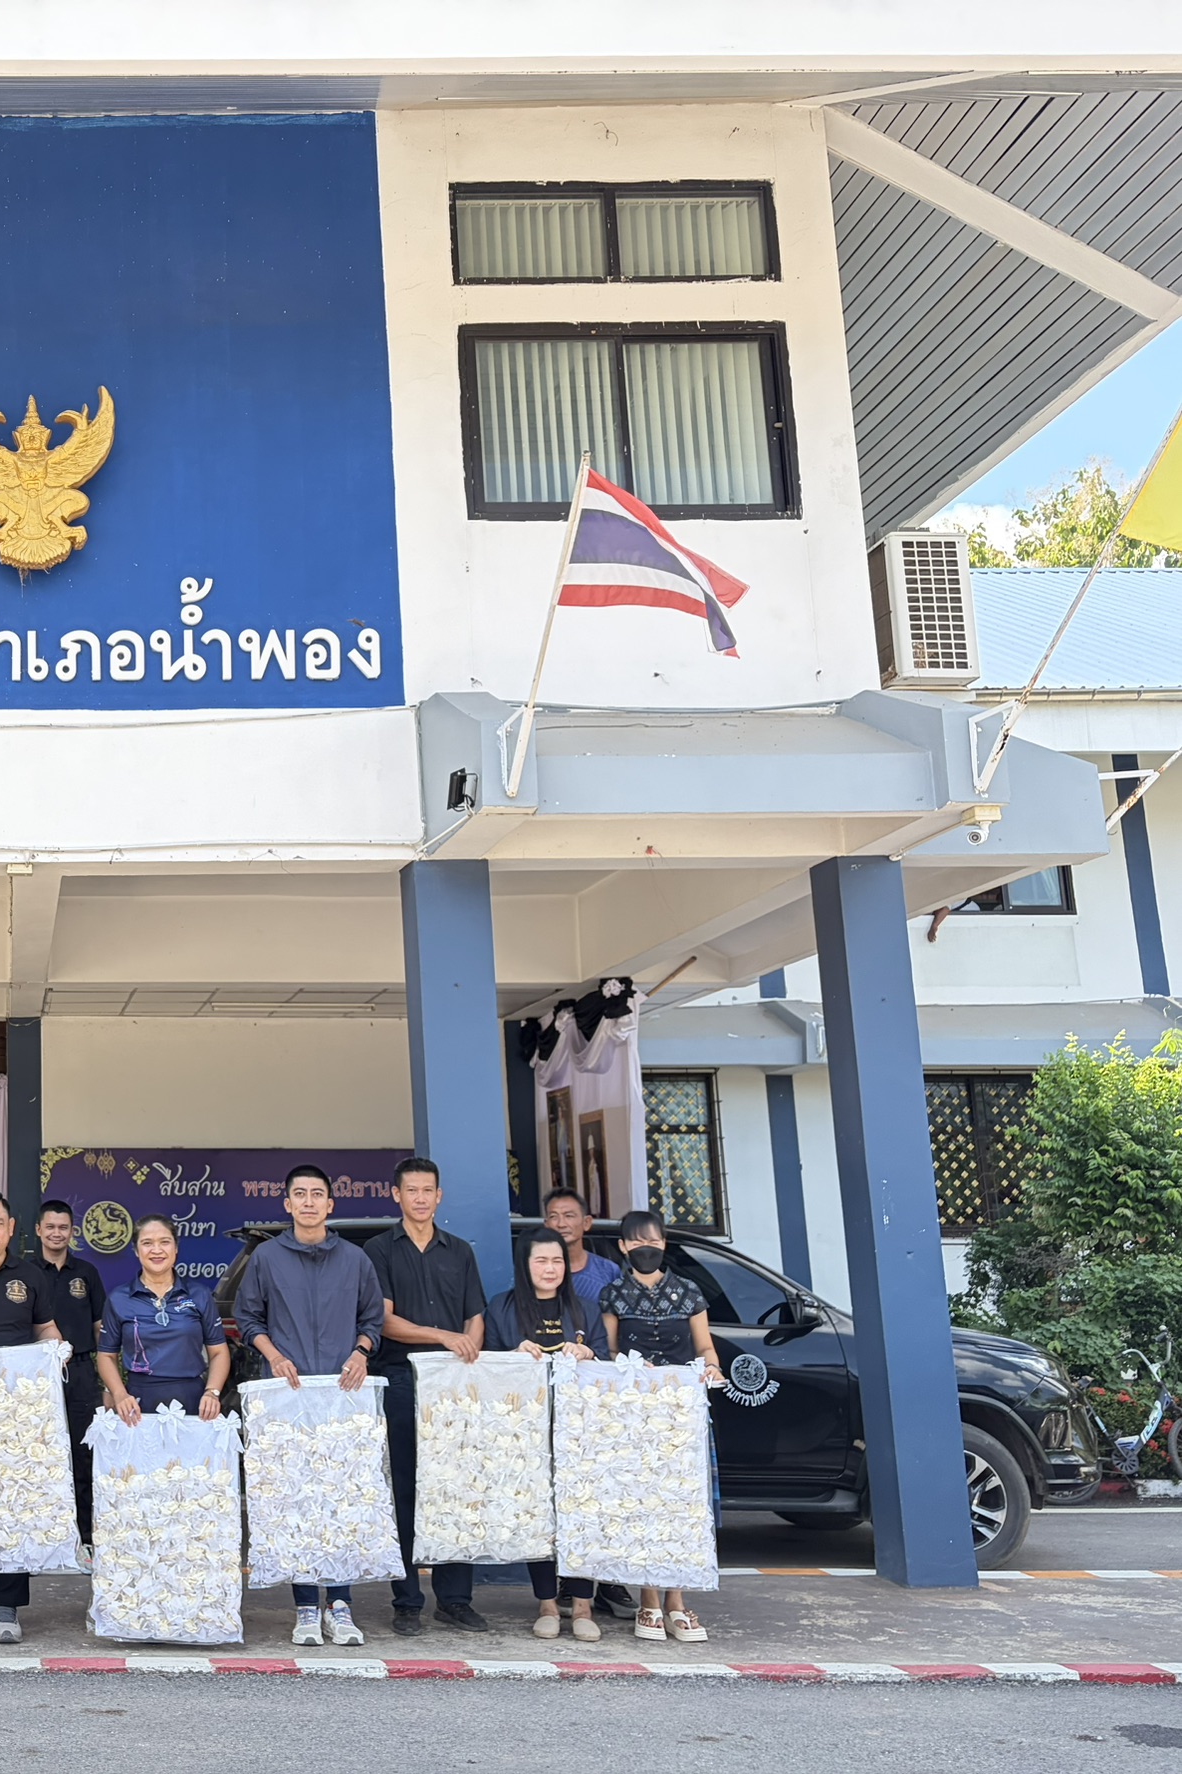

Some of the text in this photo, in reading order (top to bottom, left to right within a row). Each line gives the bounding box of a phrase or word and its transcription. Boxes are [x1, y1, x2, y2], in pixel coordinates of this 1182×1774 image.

[152, 1162, 391, 1198] สืบสาน พระณิธาน
[171, 1203, 216, 1237] ักษา
[175, 1262, 229, 1278] อยอด
[723, 1380, 780, 1407] รมการปกครอง
